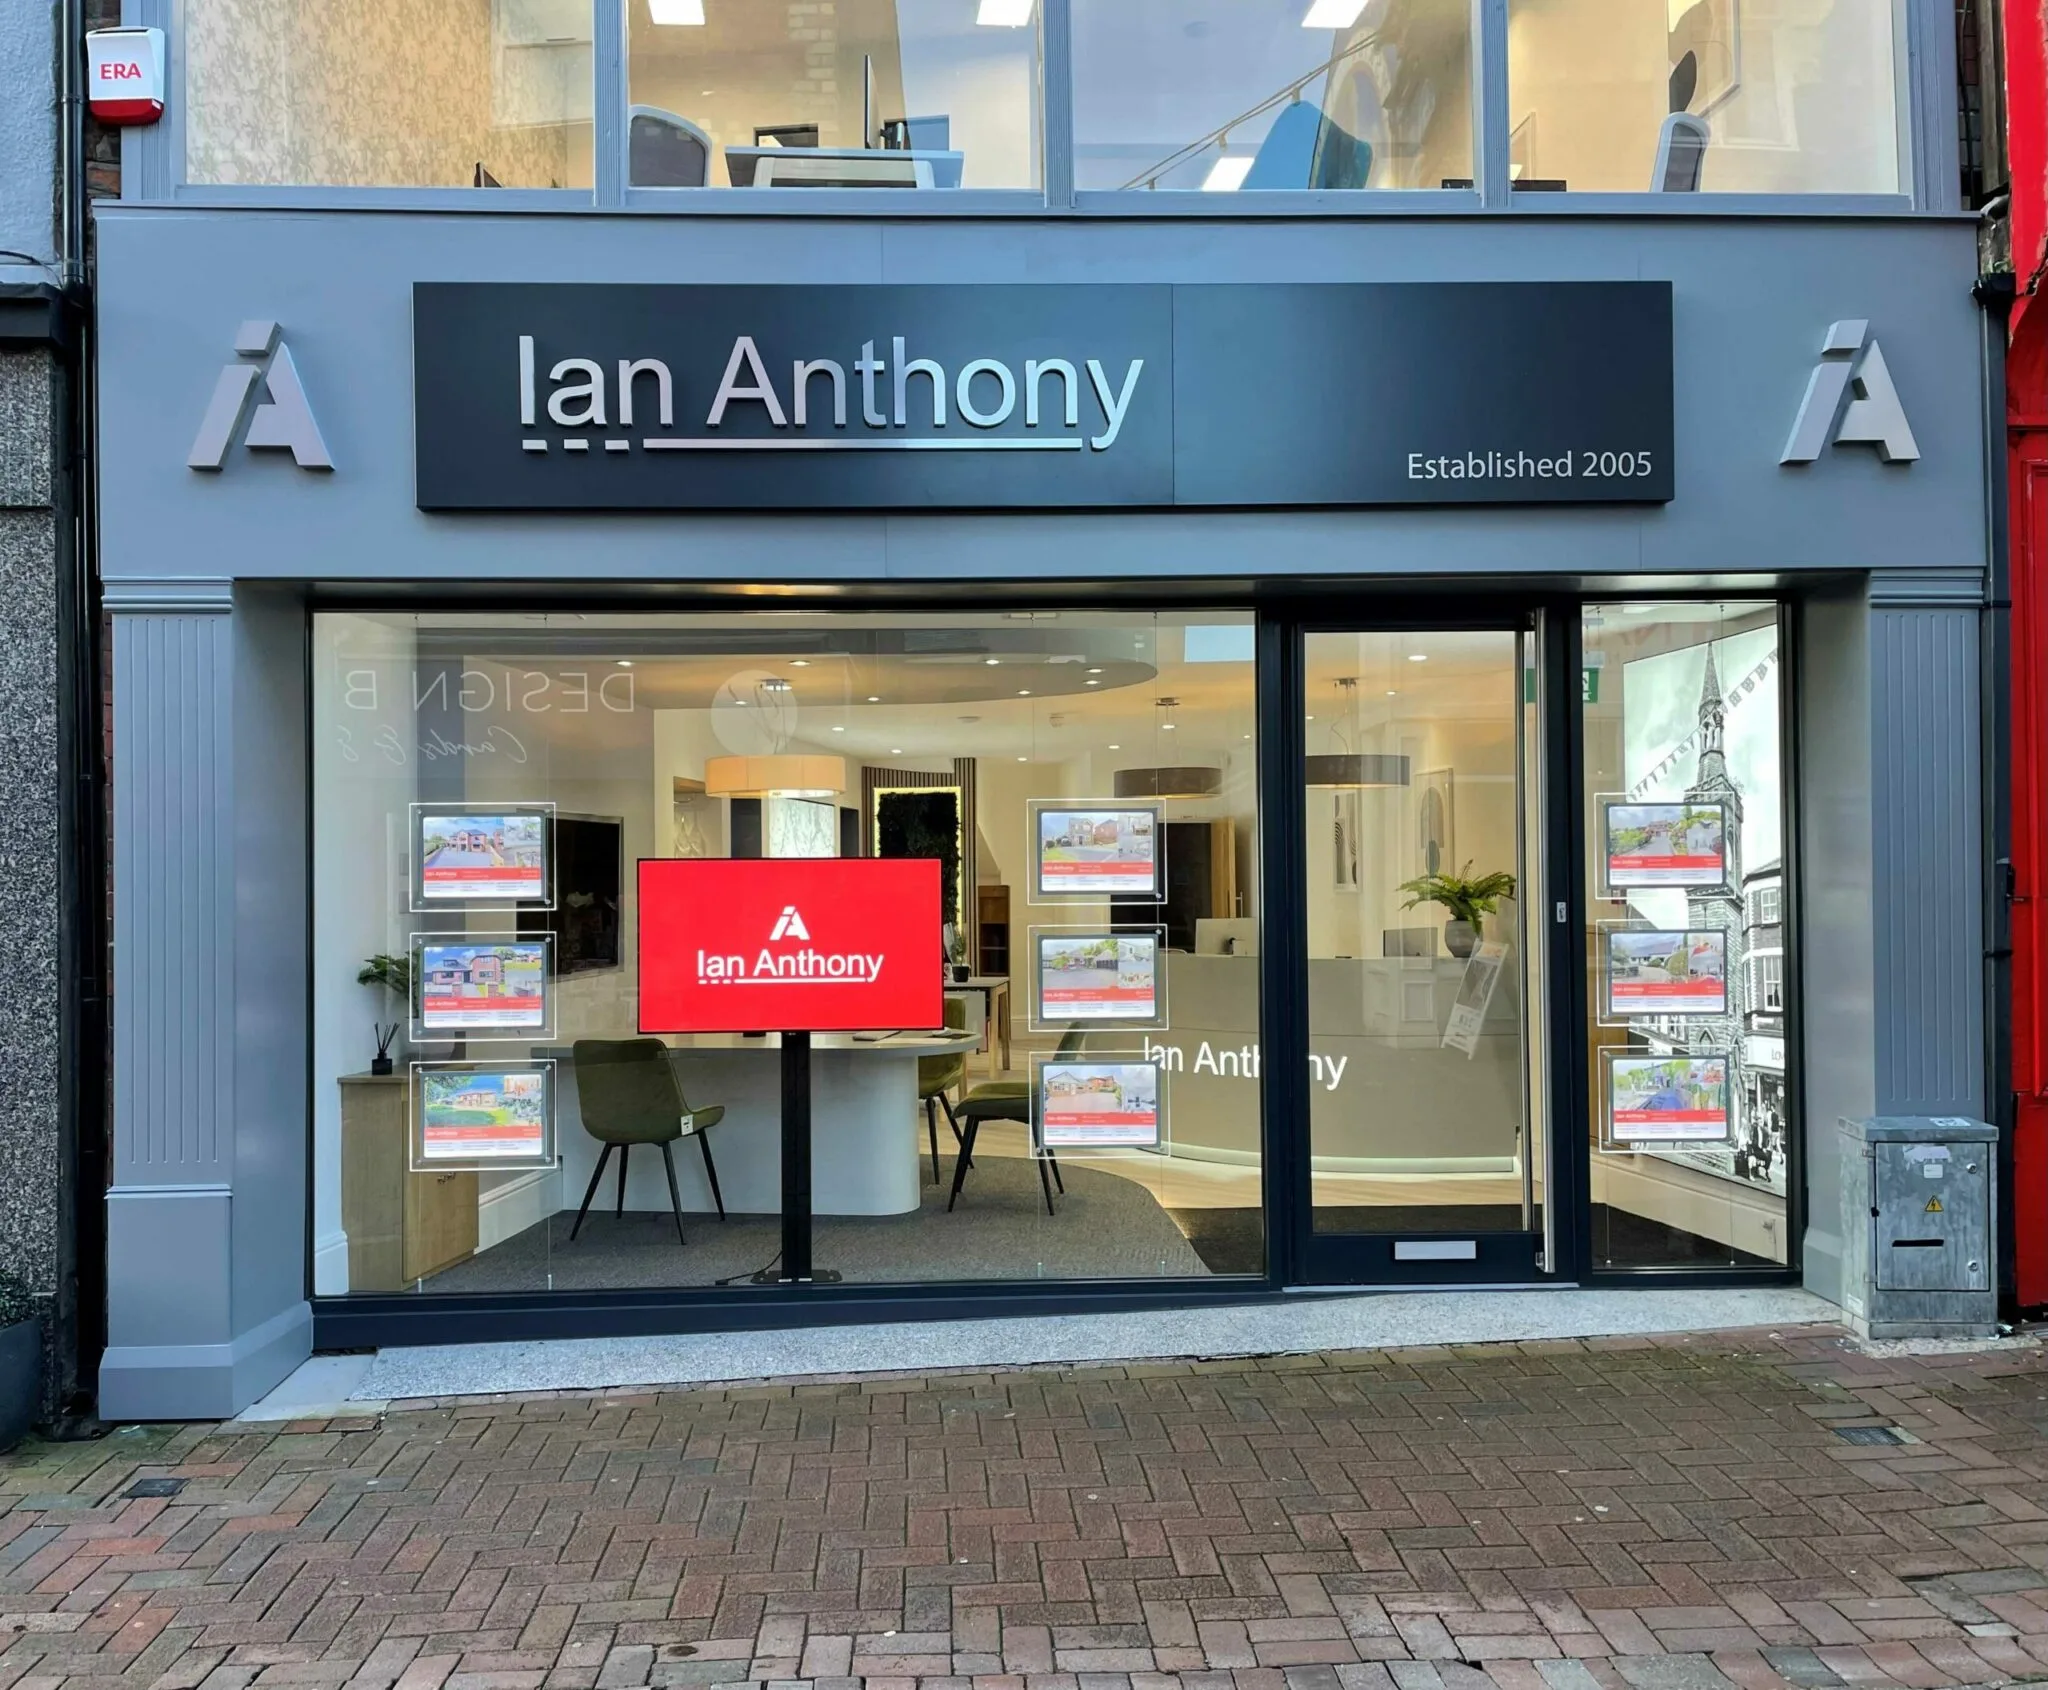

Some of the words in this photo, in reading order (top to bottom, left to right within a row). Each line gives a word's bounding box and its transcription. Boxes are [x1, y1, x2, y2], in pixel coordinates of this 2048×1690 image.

[100, 63, 142, 80] ERA
[519, 335, 674, 428] Ian
[705, 335, 1144, 449] Anthony
[1407, 450, 1573, 481] Established
[1582, 450, 1652, 479] 2005
[697, 949, 745, 978] Ian
[752, 948, 884, 983] Anthony
[1193, 1041, 1348, 1091] Antny
